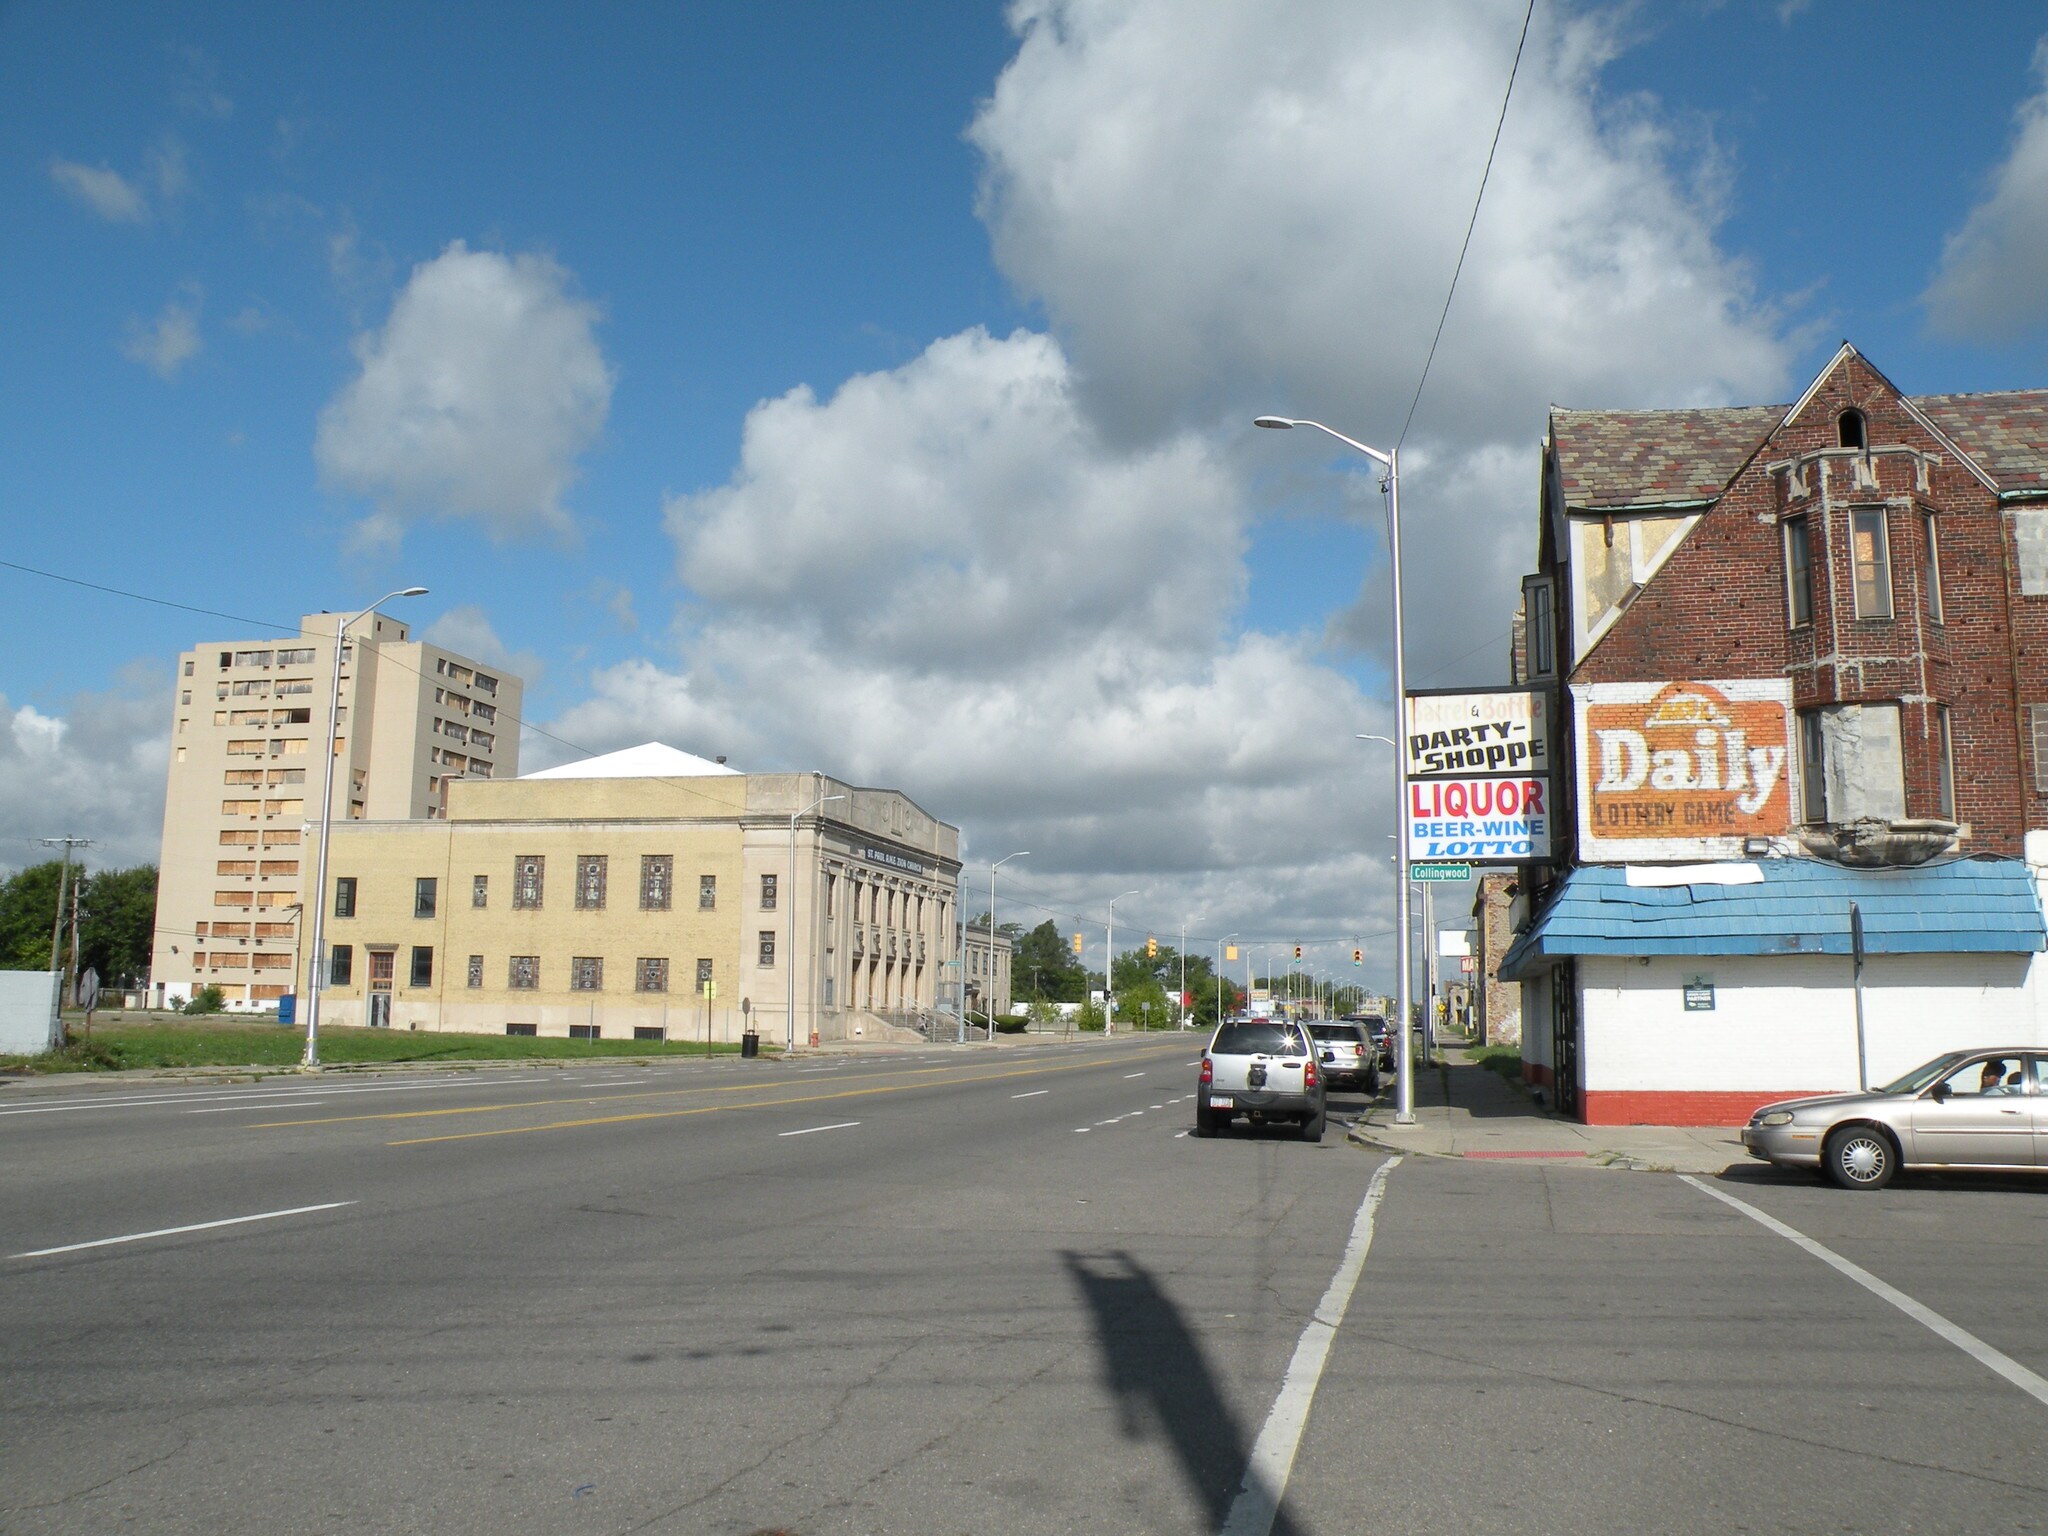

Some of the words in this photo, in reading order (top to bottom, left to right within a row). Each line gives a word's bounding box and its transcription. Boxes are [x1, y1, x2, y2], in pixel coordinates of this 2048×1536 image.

[1420, 739, 1545, 773] SHOPPE
[1595, 728, 1786, 814] Daily
[1413, 781, 1545, 819] LIQUOR
[1596, 802, 1675, 826] LOTTERY
[1684, 801, 1736, 825] GAME
[1414, 820, 1544, 838] BEER-WINE
[1426, 840, 1535, 857] LOTTO
[1414, 867, 1468, 880] Collingwood
